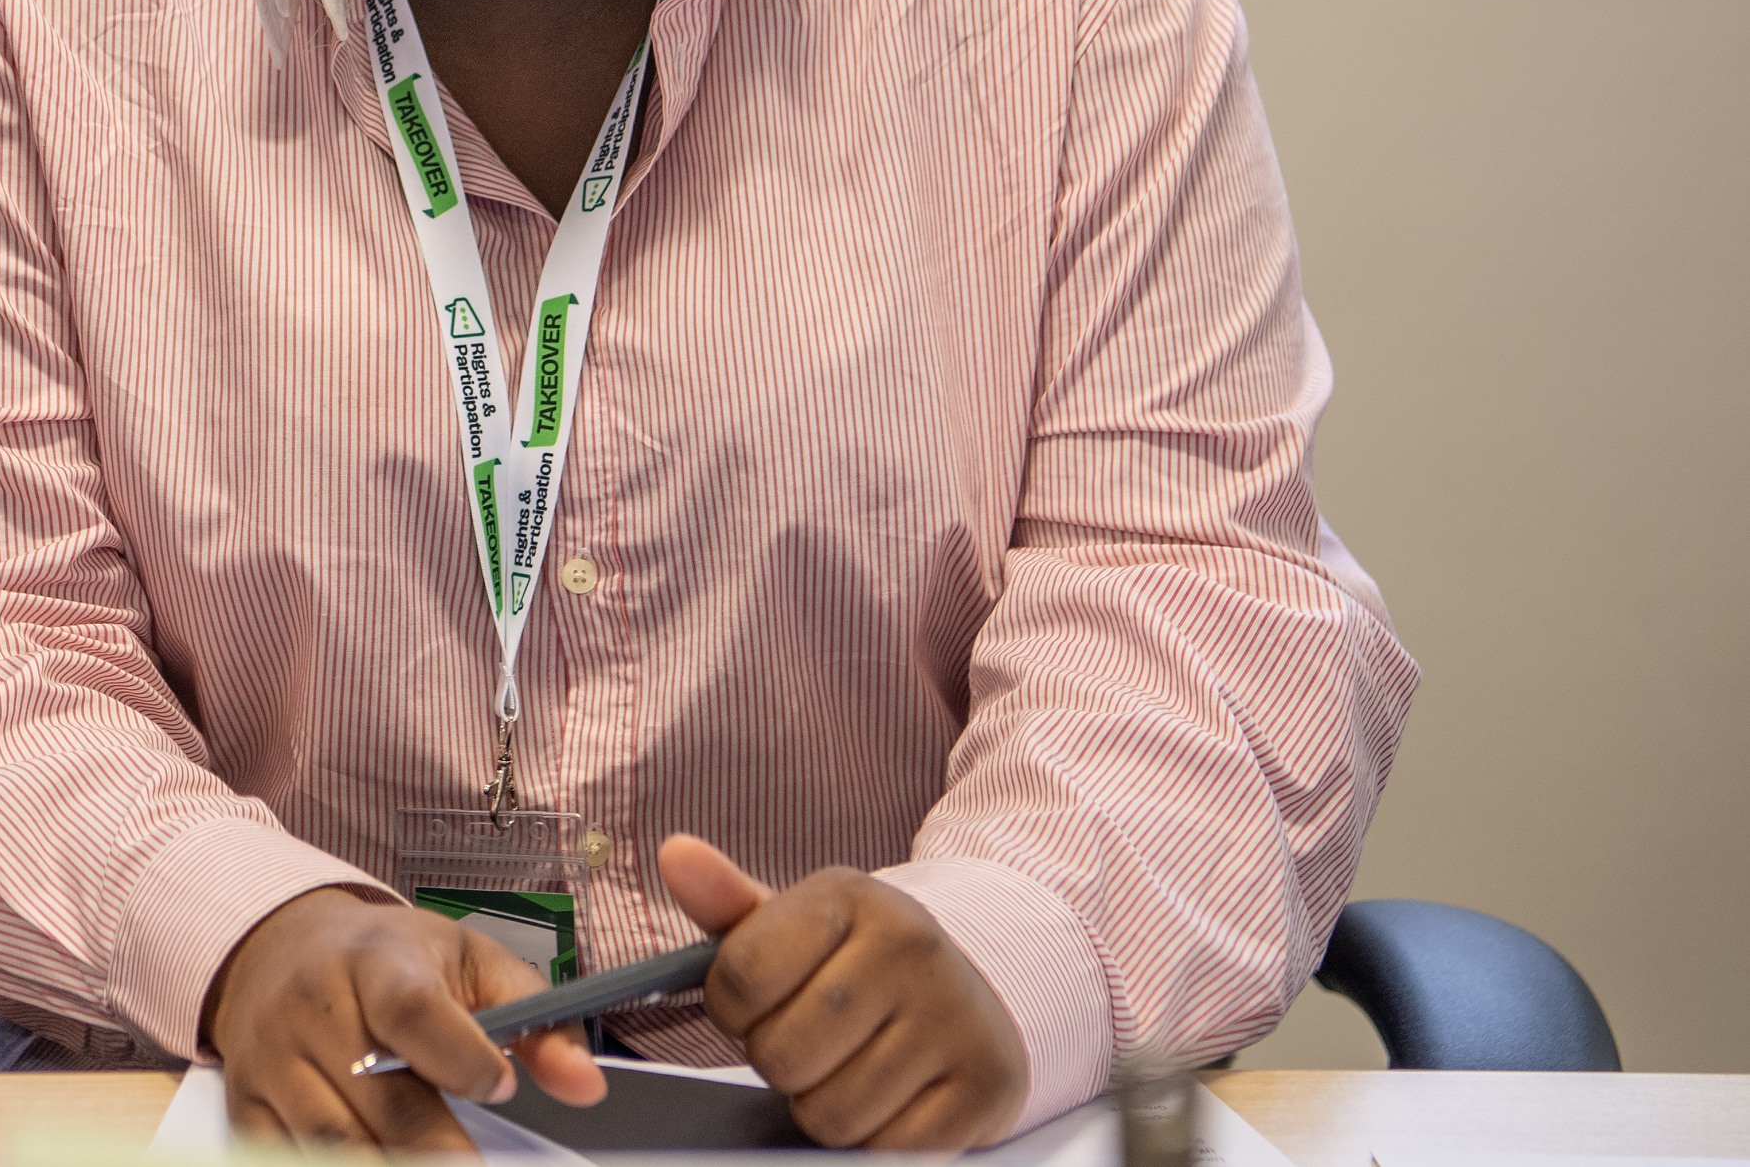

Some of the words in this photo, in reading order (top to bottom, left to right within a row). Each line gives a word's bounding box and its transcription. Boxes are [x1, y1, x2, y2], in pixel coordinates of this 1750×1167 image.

[391, 29, 404, 44] &
[394, 91, 449, 198] TAKEOVER
[591, 119, 616, 173] Rights
[611, 106, 621, 120] &
[604, 67, 639, 170] Participation
[454, 344, 482, 458] Participation
[470, 342, 491, 399] Rights
[482, 403, 496, 417] &
[537, 314, 562, 434] TAKEOVER
[478, 475, 501, 597] TAKEOVER
[514, 508, 530, 567] Rights
[518, 489, 531, 505] &
[524, 452, 554, 568] Participation
